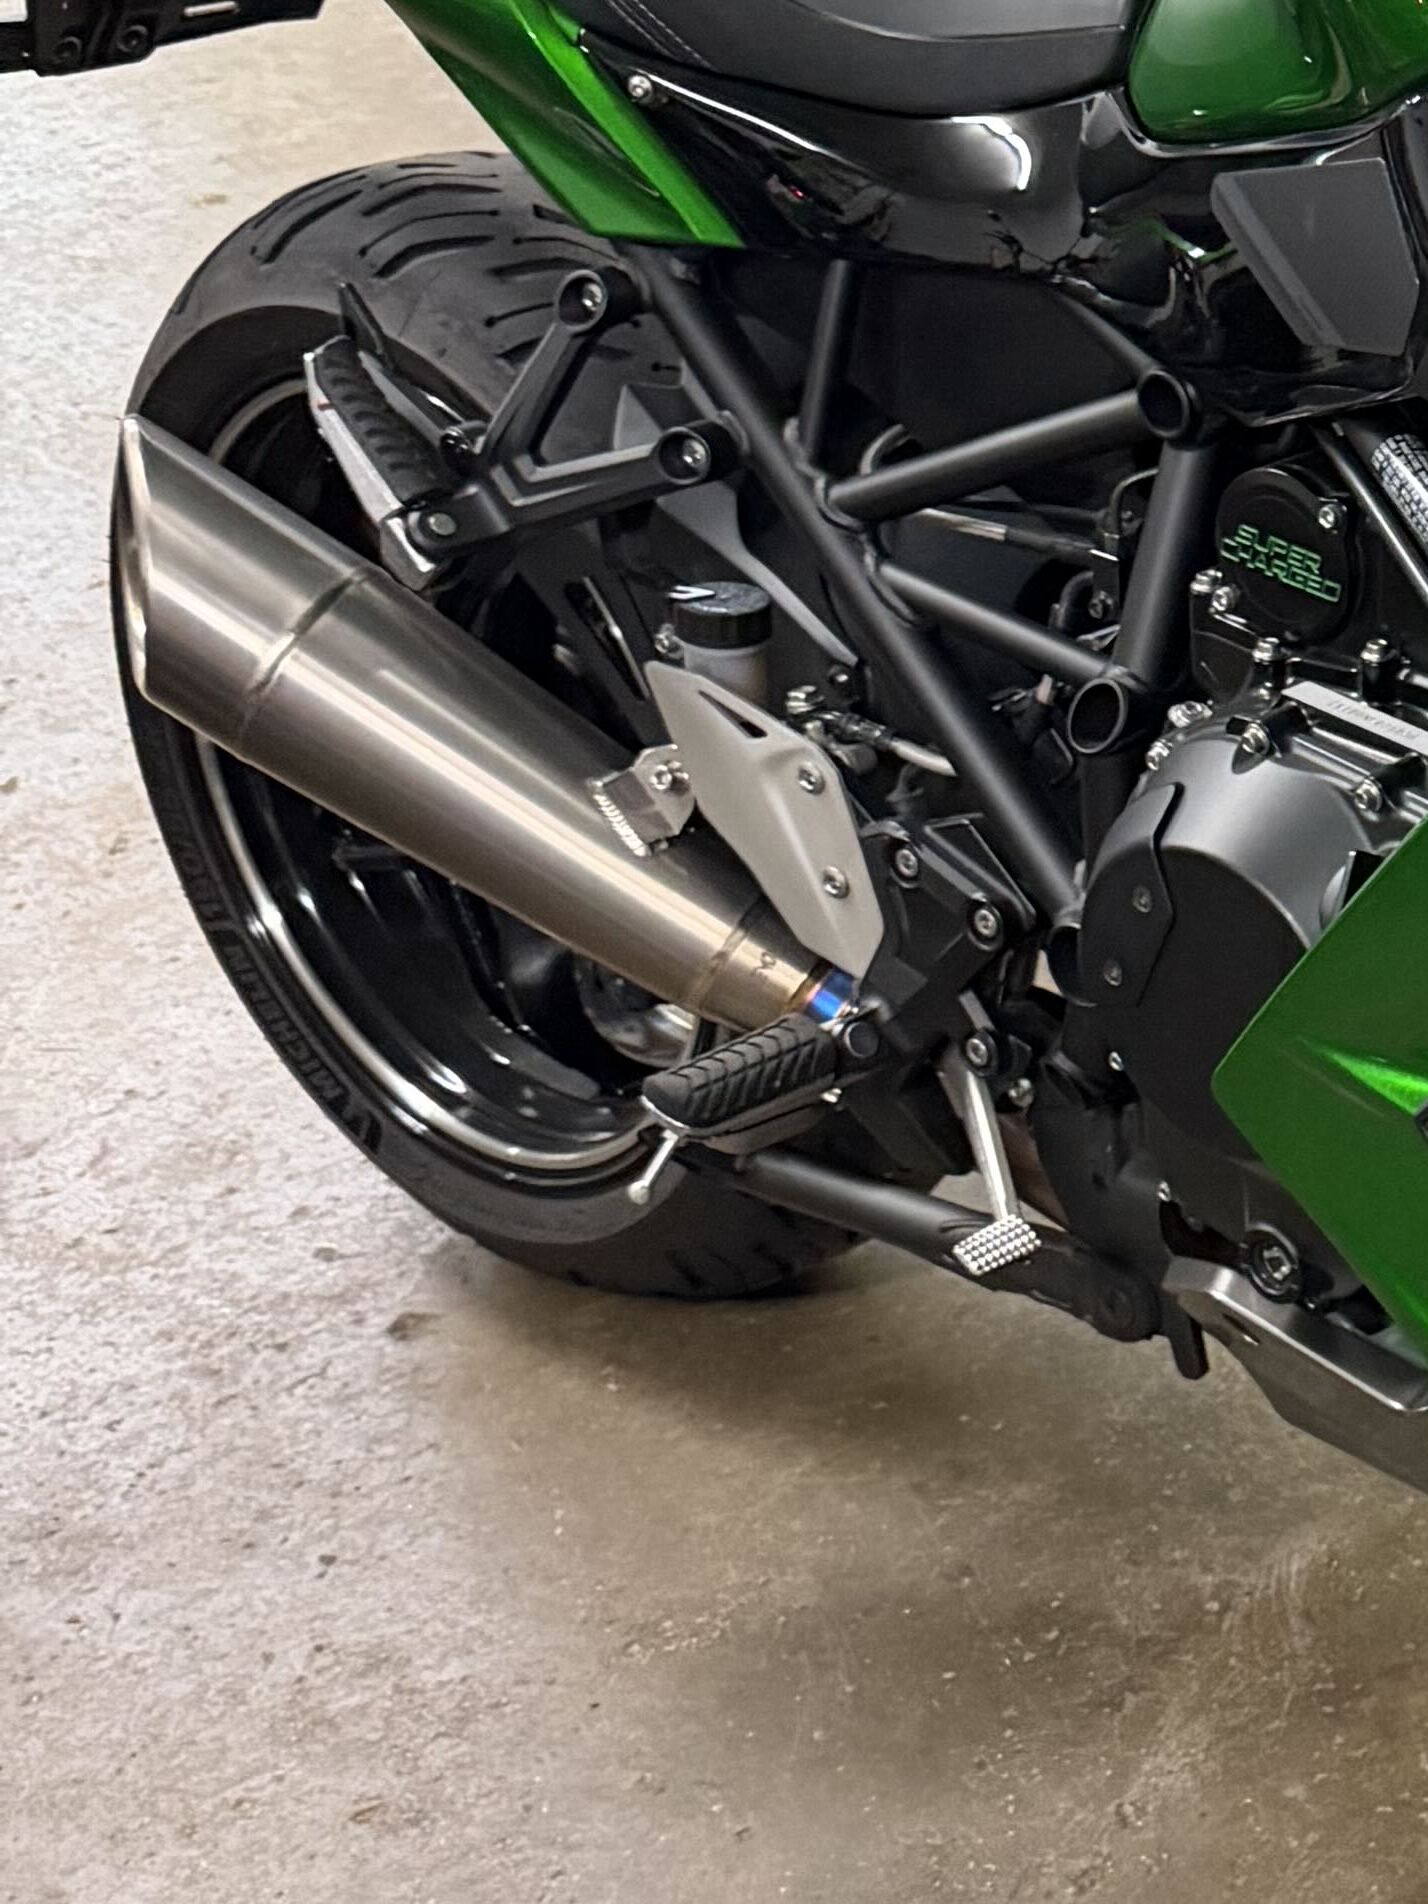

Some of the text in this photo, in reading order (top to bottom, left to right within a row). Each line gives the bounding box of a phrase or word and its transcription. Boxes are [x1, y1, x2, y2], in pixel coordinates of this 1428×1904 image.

[1220, 537, 1341, 603] CHARGED
[1234, 523, 1323, 576] SUPER
[224, 942, 353, 1100] MICHELIN
